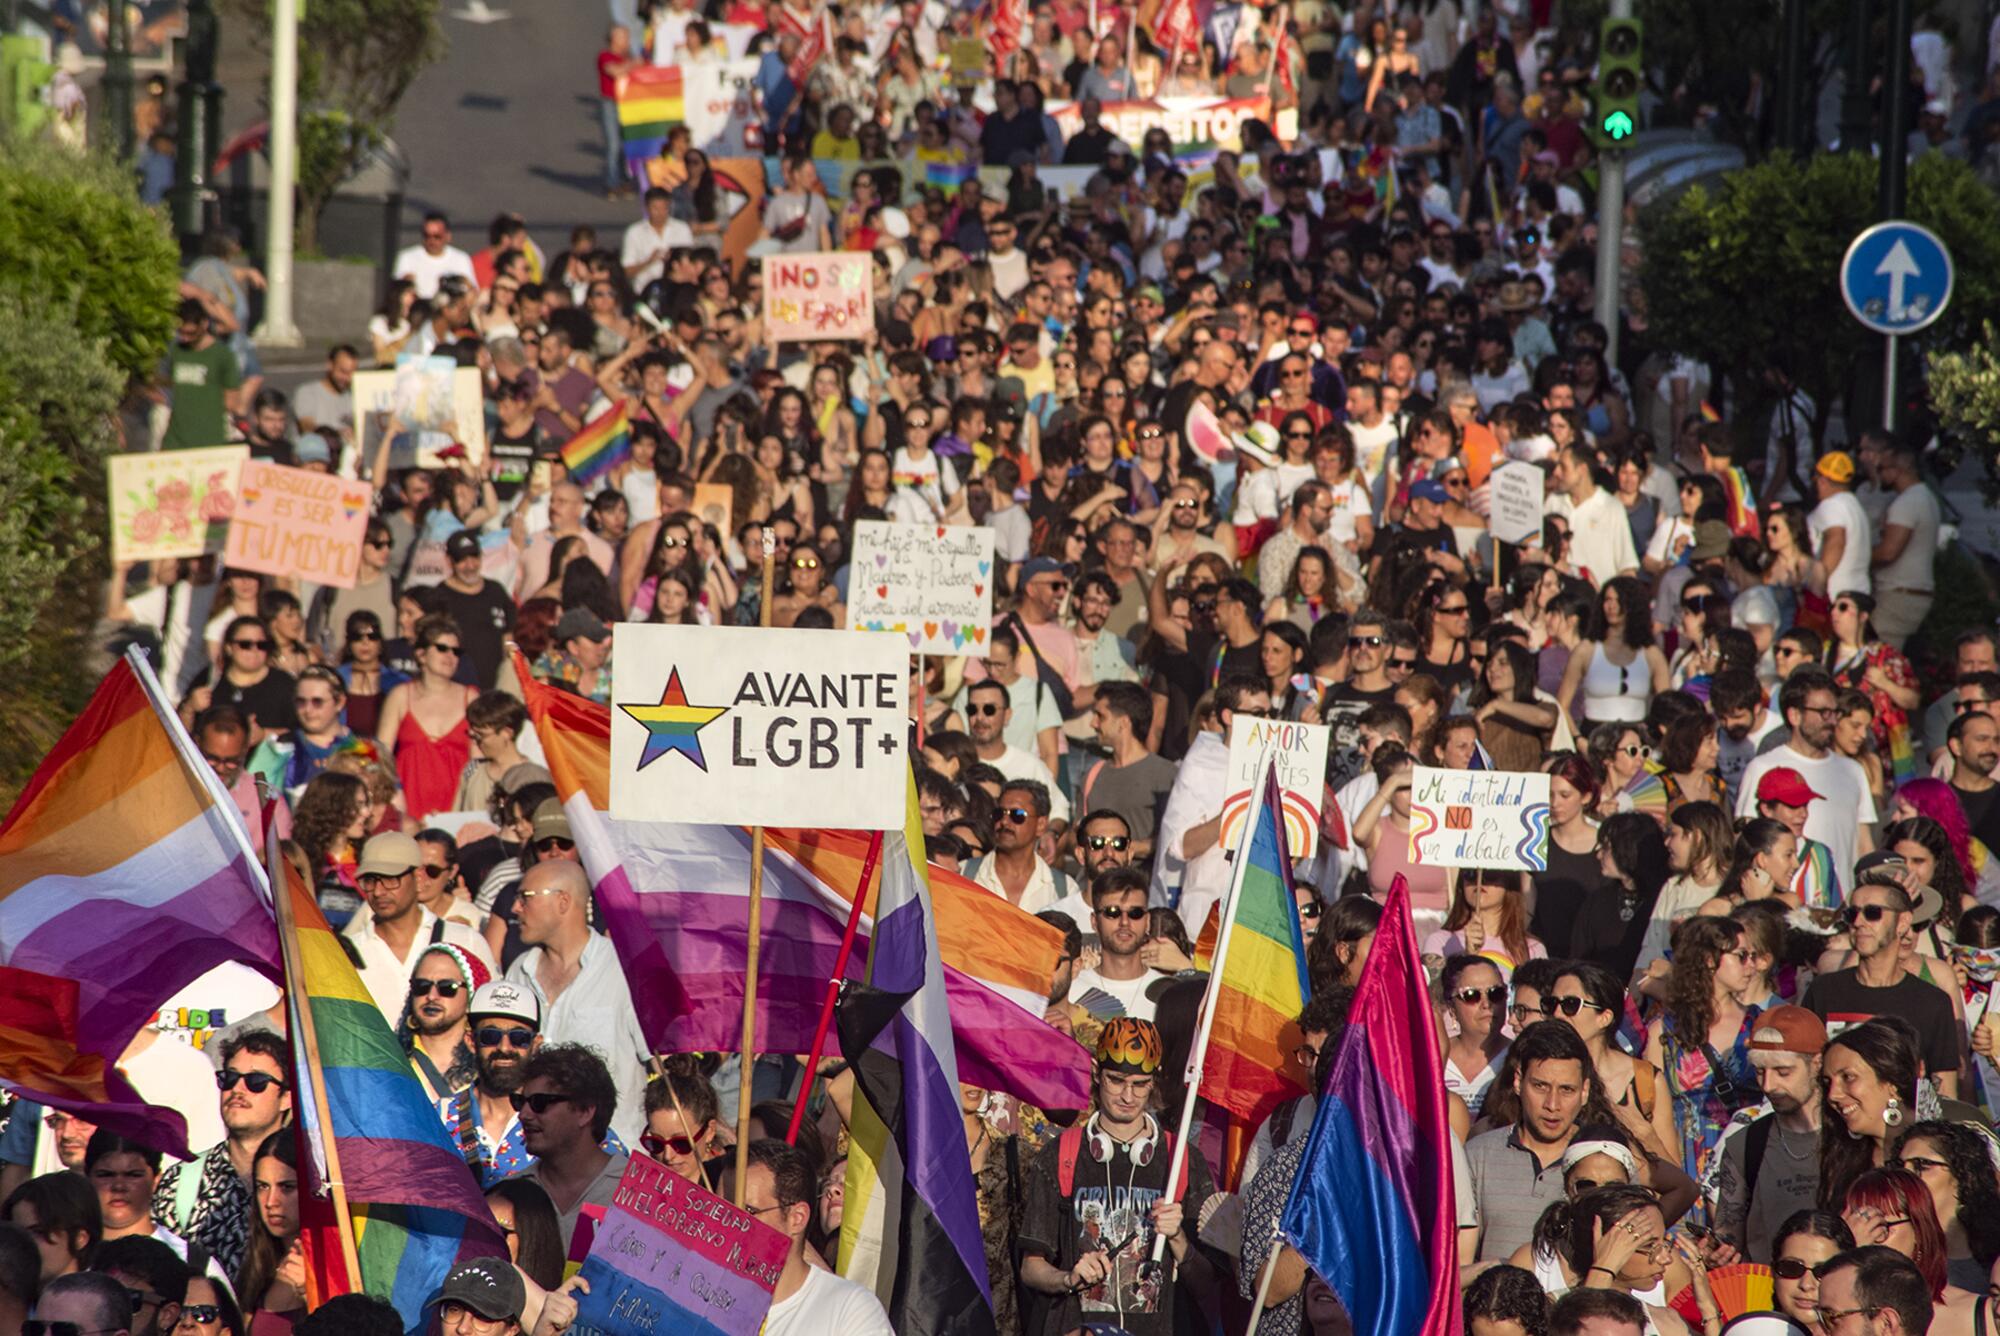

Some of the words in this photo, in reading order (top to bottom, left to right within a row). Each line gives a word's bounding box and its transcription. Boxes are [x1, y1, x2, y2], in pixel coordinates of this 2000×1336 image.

[273, 496, 296, 517] ES
[302, 502, 335, 525] SER
[279, 530, 357, 577] MISMO
[938, 534, 982, 568] orgullo
[858, 560, 911, 590] Madres
[914, 567, 927, 590] y
[930, 558, 977, 588] Padres
[854, 590, 896, 622] fuera
[900, 594, 923, 616] del
[928, 601, 979, 618] armario
[732, 671, 898, 708] AVANTE
[732, 716, 898, 769] LGBT+
[1247, 722, 1310, 753] AMOR
[1419, 773, 1446, 804] Mi
[1457, 775, 1526, 807] identidad
[1446, 807, 1472, 829] NO
[1483, 817, 1498, 832] es
[1423, 841, 1440, 861] un
[1455, 832, 1510, 861] debate
[627, 1161, 647, 1183] NI
[655, 1172, 675, 1196] LA
[685, 1187, 751, 1233] SOCIEDAD
[654, 1201, 726, 1248] GOBIERNO
[650, 1250, 667, 1273] Y
[669, 1261, 683, 1285] A
